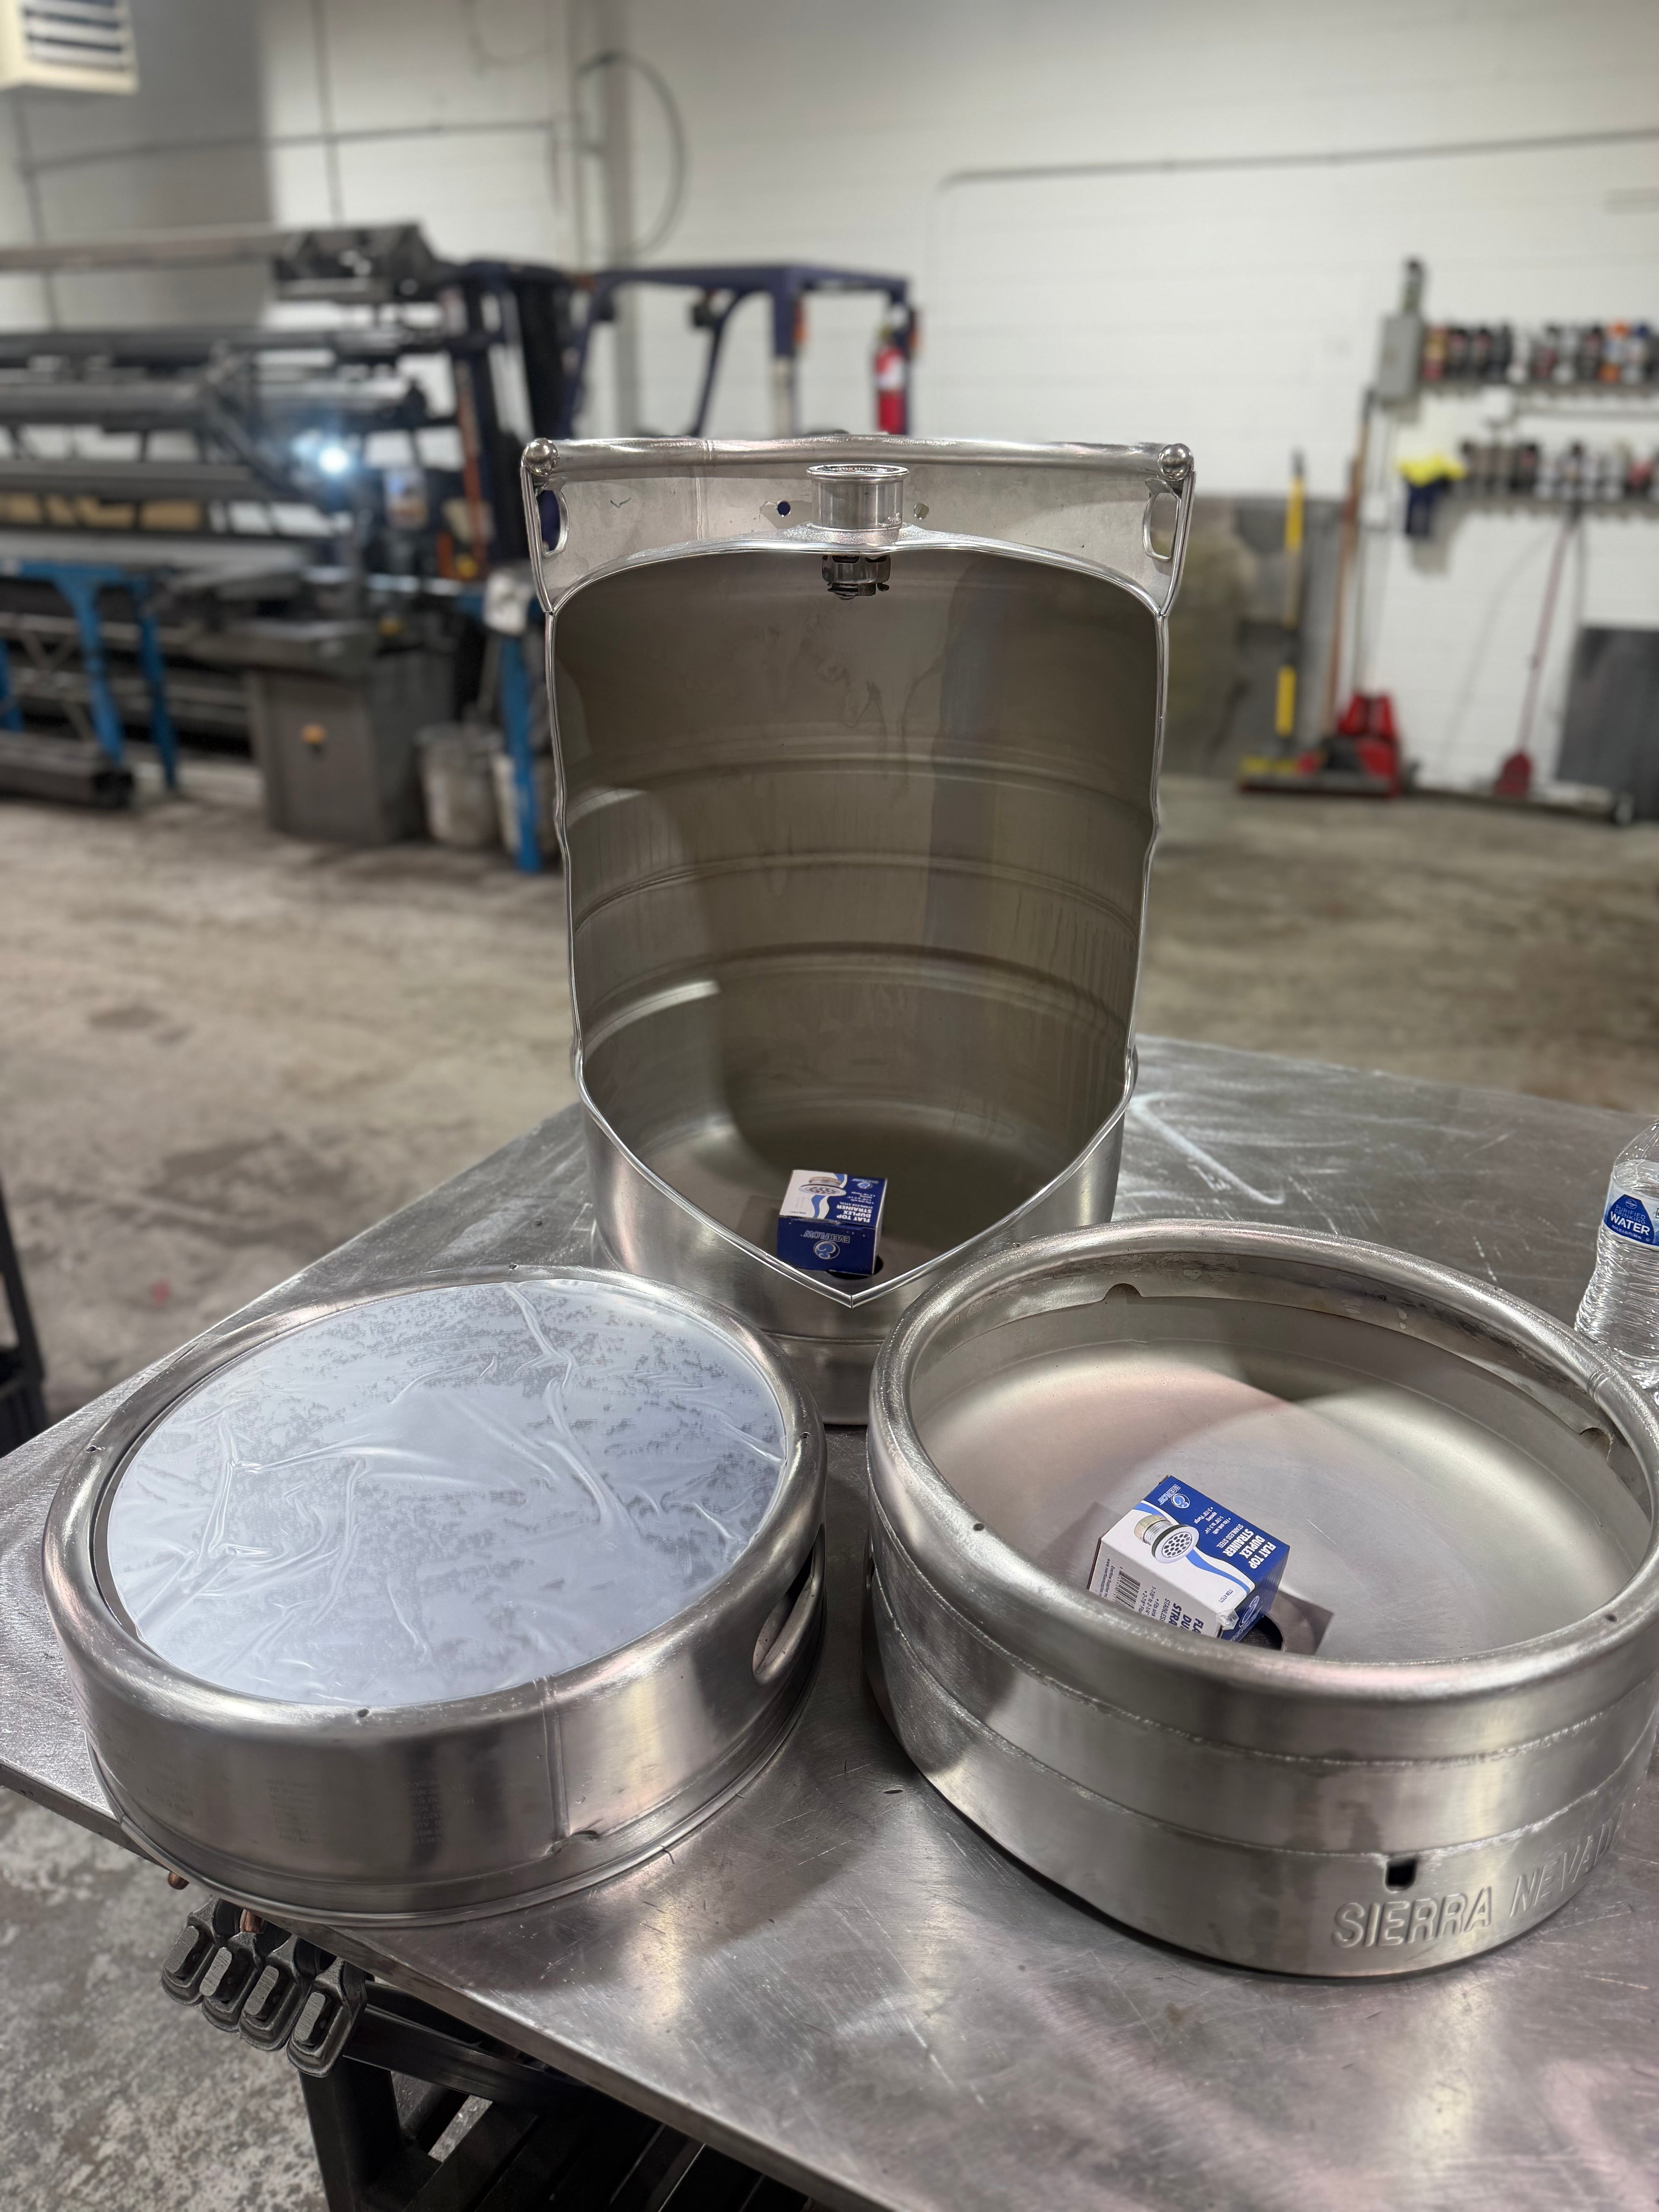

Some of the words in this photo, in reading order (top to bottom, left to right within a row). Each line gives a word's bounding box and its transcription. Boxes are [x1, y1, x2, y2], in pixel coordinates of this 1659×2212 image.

[836, 1205, 872, 1213] STRAINER
[1615, 1209, 1646, 1224] DRINKING
[1616, 1205, 1646, 1219] PURIFIED
[1611, 1211, 1650, 1236] WATER
[803, 1230, 850, 1243] EVERFLOW
[1225, 1523, 1244, 1540] STAINLESS
[1216, 1538, 1228, 1548] STEEL
[1222, 1528, 1254, 1557] STRAINER
[1239, 1535, 1265, 1559] DUPLEX
[1258, 1541, 1276, 1557] FLAT
[1247, 1554, 1264, 1569] TOP
[1168, 1602, 1182, 1626] STRA
[1180, 1614, 1192, 1630] DU
[1192, 1618, 1204, 1634] FLA
[1332, 1886, 1492, 1949] SIERRA
[1510, 1818, 1614, 1918] NEVAD
